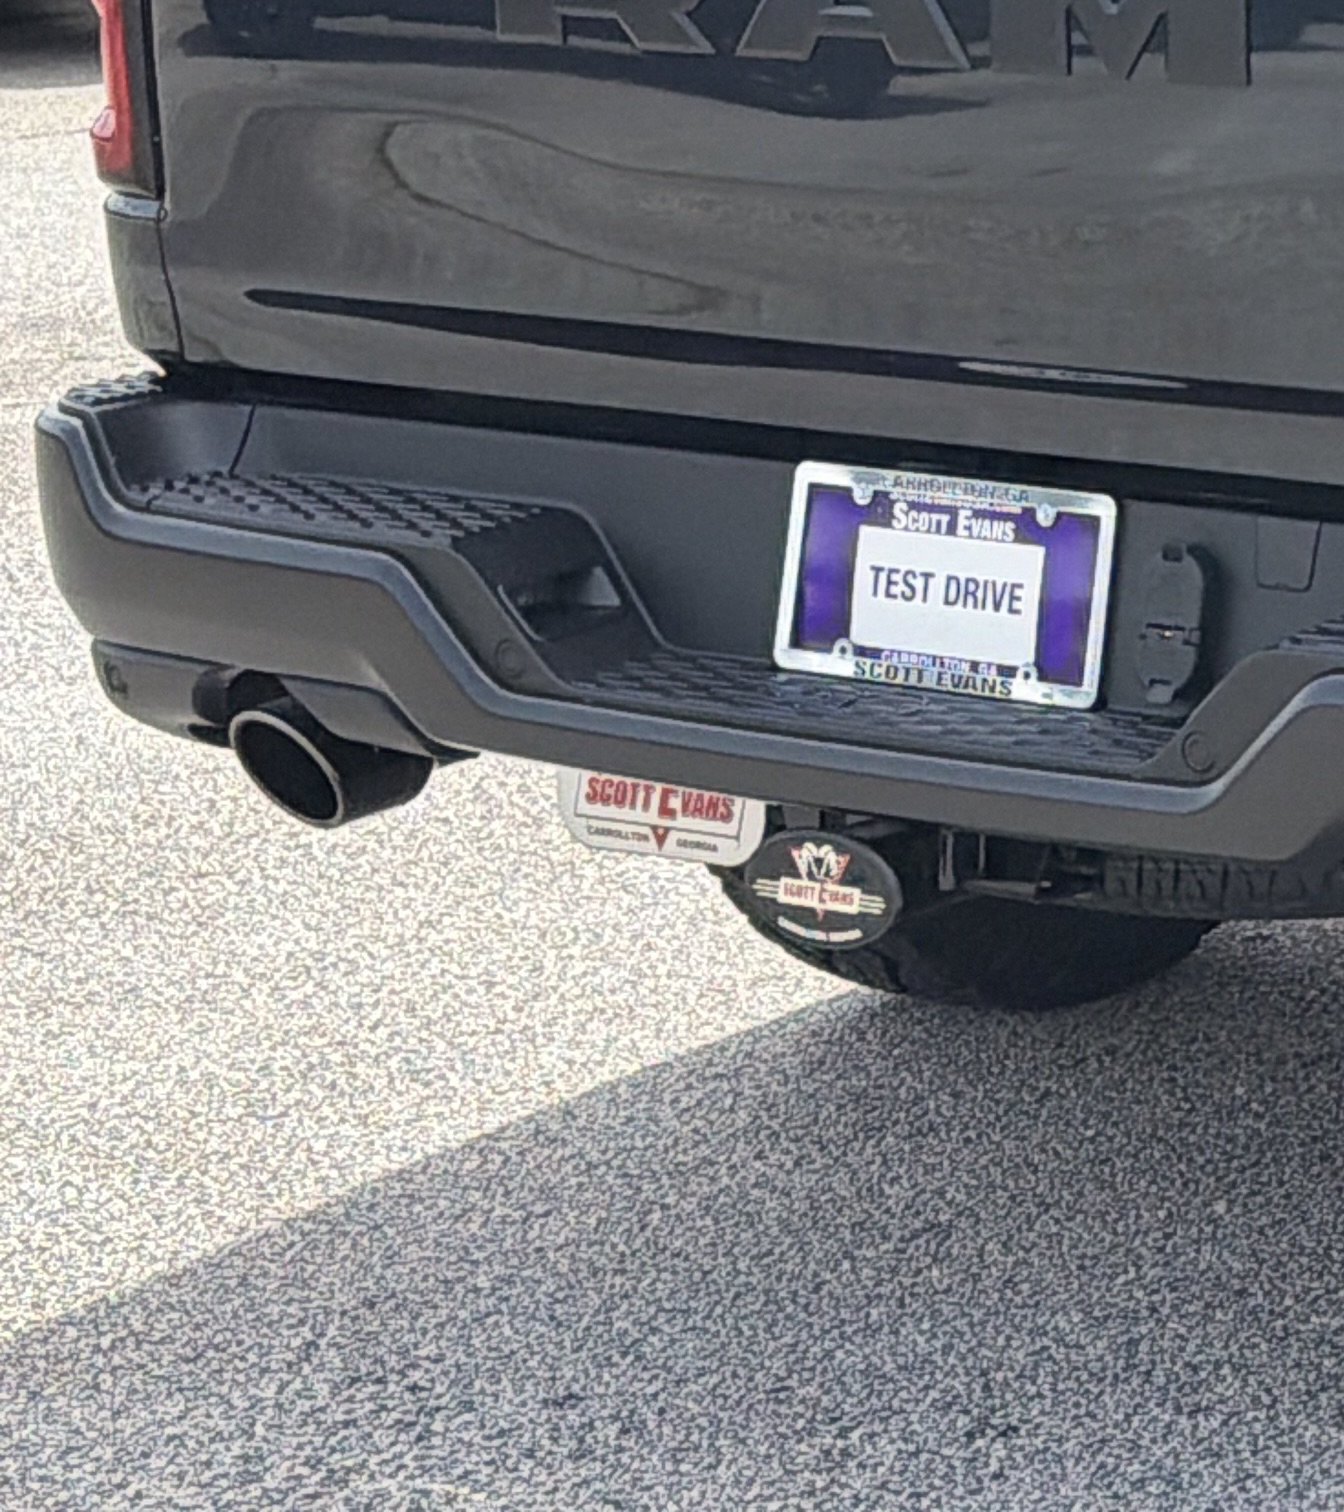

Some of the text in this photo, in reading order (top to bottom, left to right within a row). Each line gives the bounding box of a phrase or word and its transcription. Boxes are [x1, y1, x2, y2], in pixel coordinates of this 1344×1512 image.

[891, 502, 950, 535] SCOTT
[955, 509, 1016, 542] EVANS
[869, 564, 1025, 615] TEST DRIVE
[854, 659, 1013, 697] SCOTT EVANS
[585, 776, 735, 824] SCOTT EVANS
[586, 824, 719, 852] CARROLLTON GEORGIA
[783, 879, 855, 906] SCOTT EVANS
